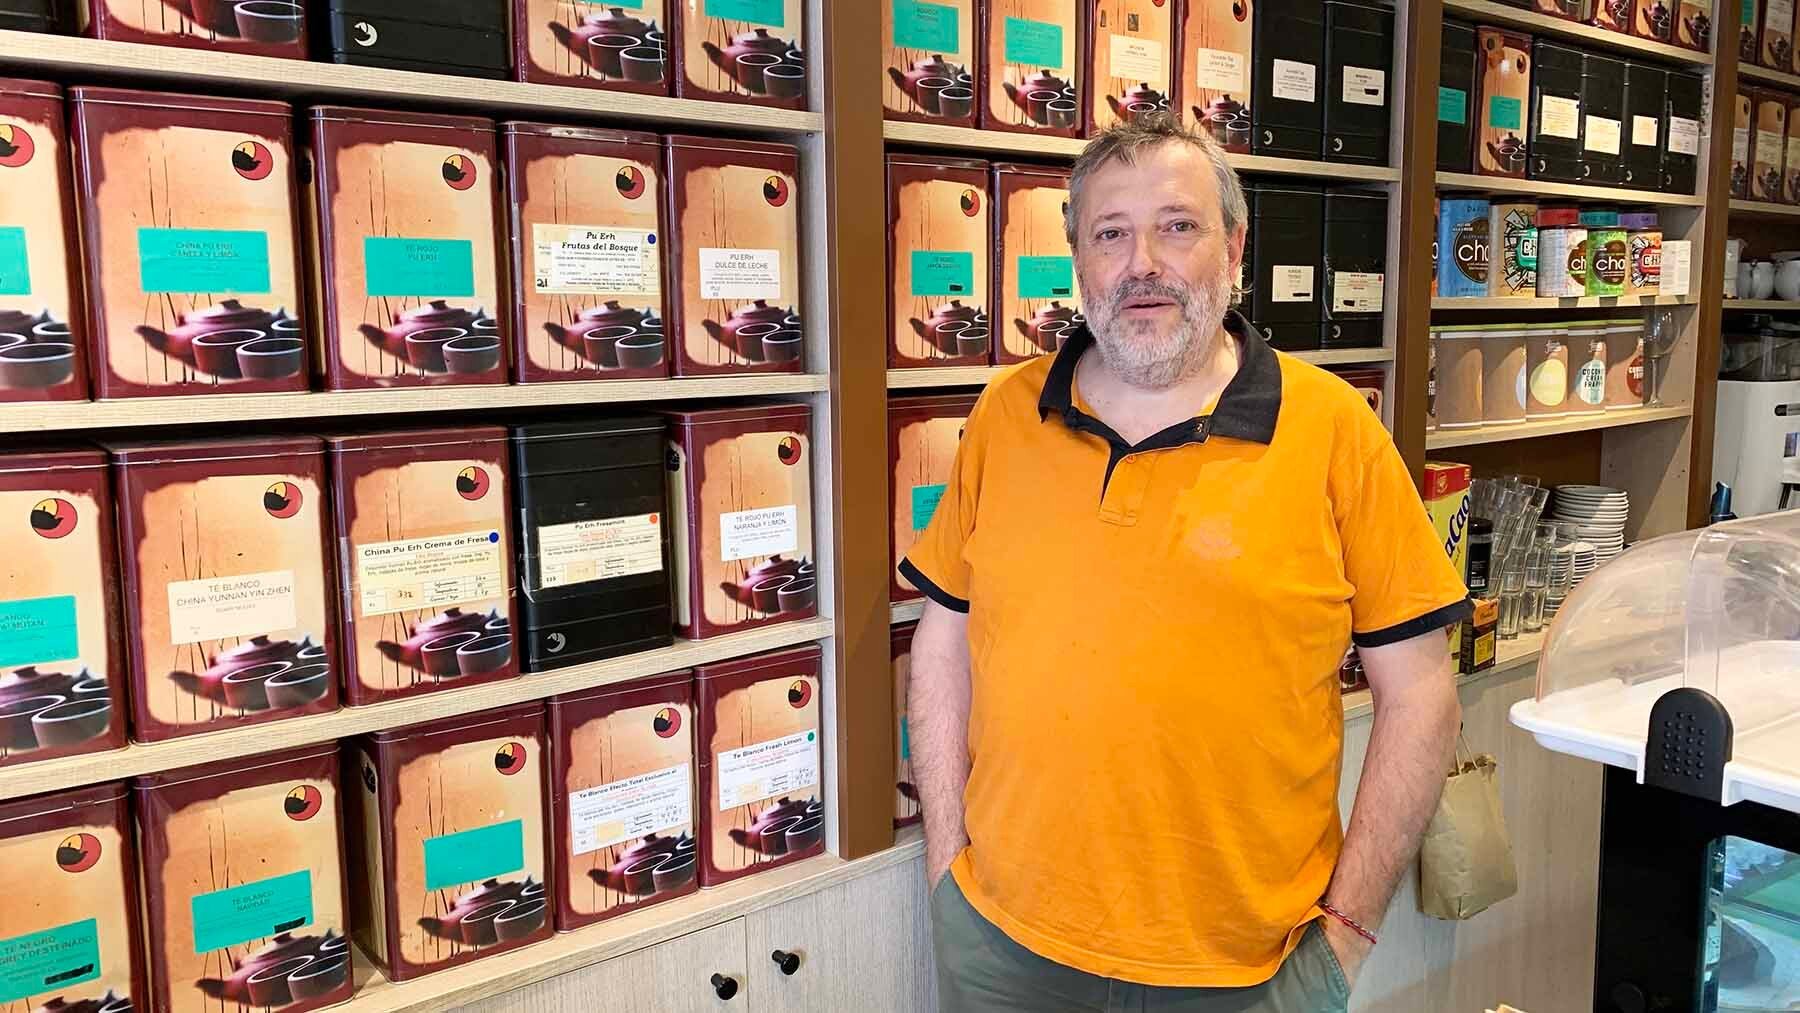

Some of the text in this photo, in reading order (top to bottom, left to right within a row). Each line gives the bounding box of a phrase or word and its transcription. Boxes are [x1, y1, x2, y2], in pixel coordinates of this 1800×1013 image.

[586, 231, 616, 240] Pu Erh
[562, 242, 638, 252] Frutas del Bosque
[734, 521, 761, 530] NARANJA
[364, 547, 391, 557] China
[407, 543, 422, 552] Erh
[424, 541, 452, 550] Crema
[455, 538, 465, 546] de
[467, 536, 489, 545] Fresa
[223, 579, 260, 591] BLANCO
[176, 585, 291, 607] CHINA YUNNAN YIN ZHEN
[765, 743, 783, 751] Fresh
[588, 788, 609, 797] Blanco
[610, 782, 628, 791] Efecto
[629, 778, 644, 786] Total
[20, 935, 56, 949] NEGRO
